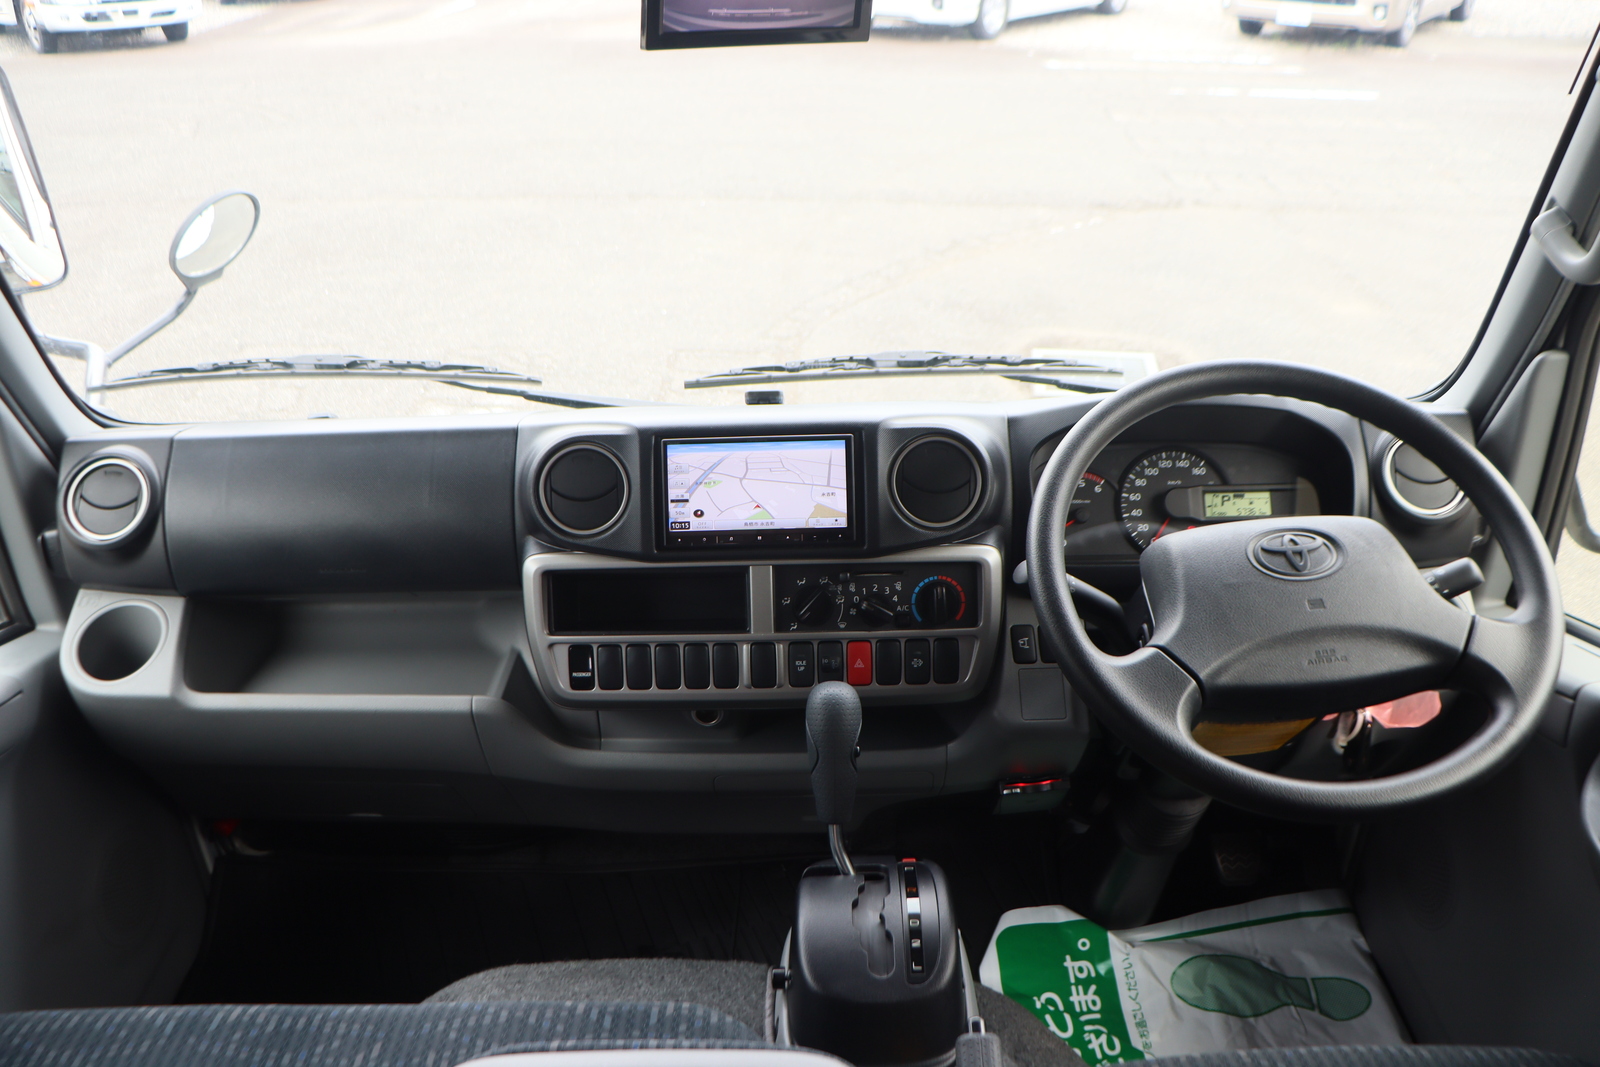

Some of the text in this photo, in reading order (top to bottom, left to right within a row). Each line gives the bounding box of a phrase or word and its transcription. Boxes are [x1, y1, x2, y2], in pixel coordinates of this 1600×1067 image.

[1158, 459, 1172, 468] 120
[1175, 459, 1190, 468] 140
[1144, 467, 1159, 476] 100
[1191, 467, 1206, 475] 160
[1135, 478, 1147, 487] 80
[1094, 485, 1102, 493] 6
[1129, 493, 1141, 501] 60
[1221, 494, 1231, 506] P
[1130, 508, 1143, 516] 40
[1137, 523, 1149, 531] 20
